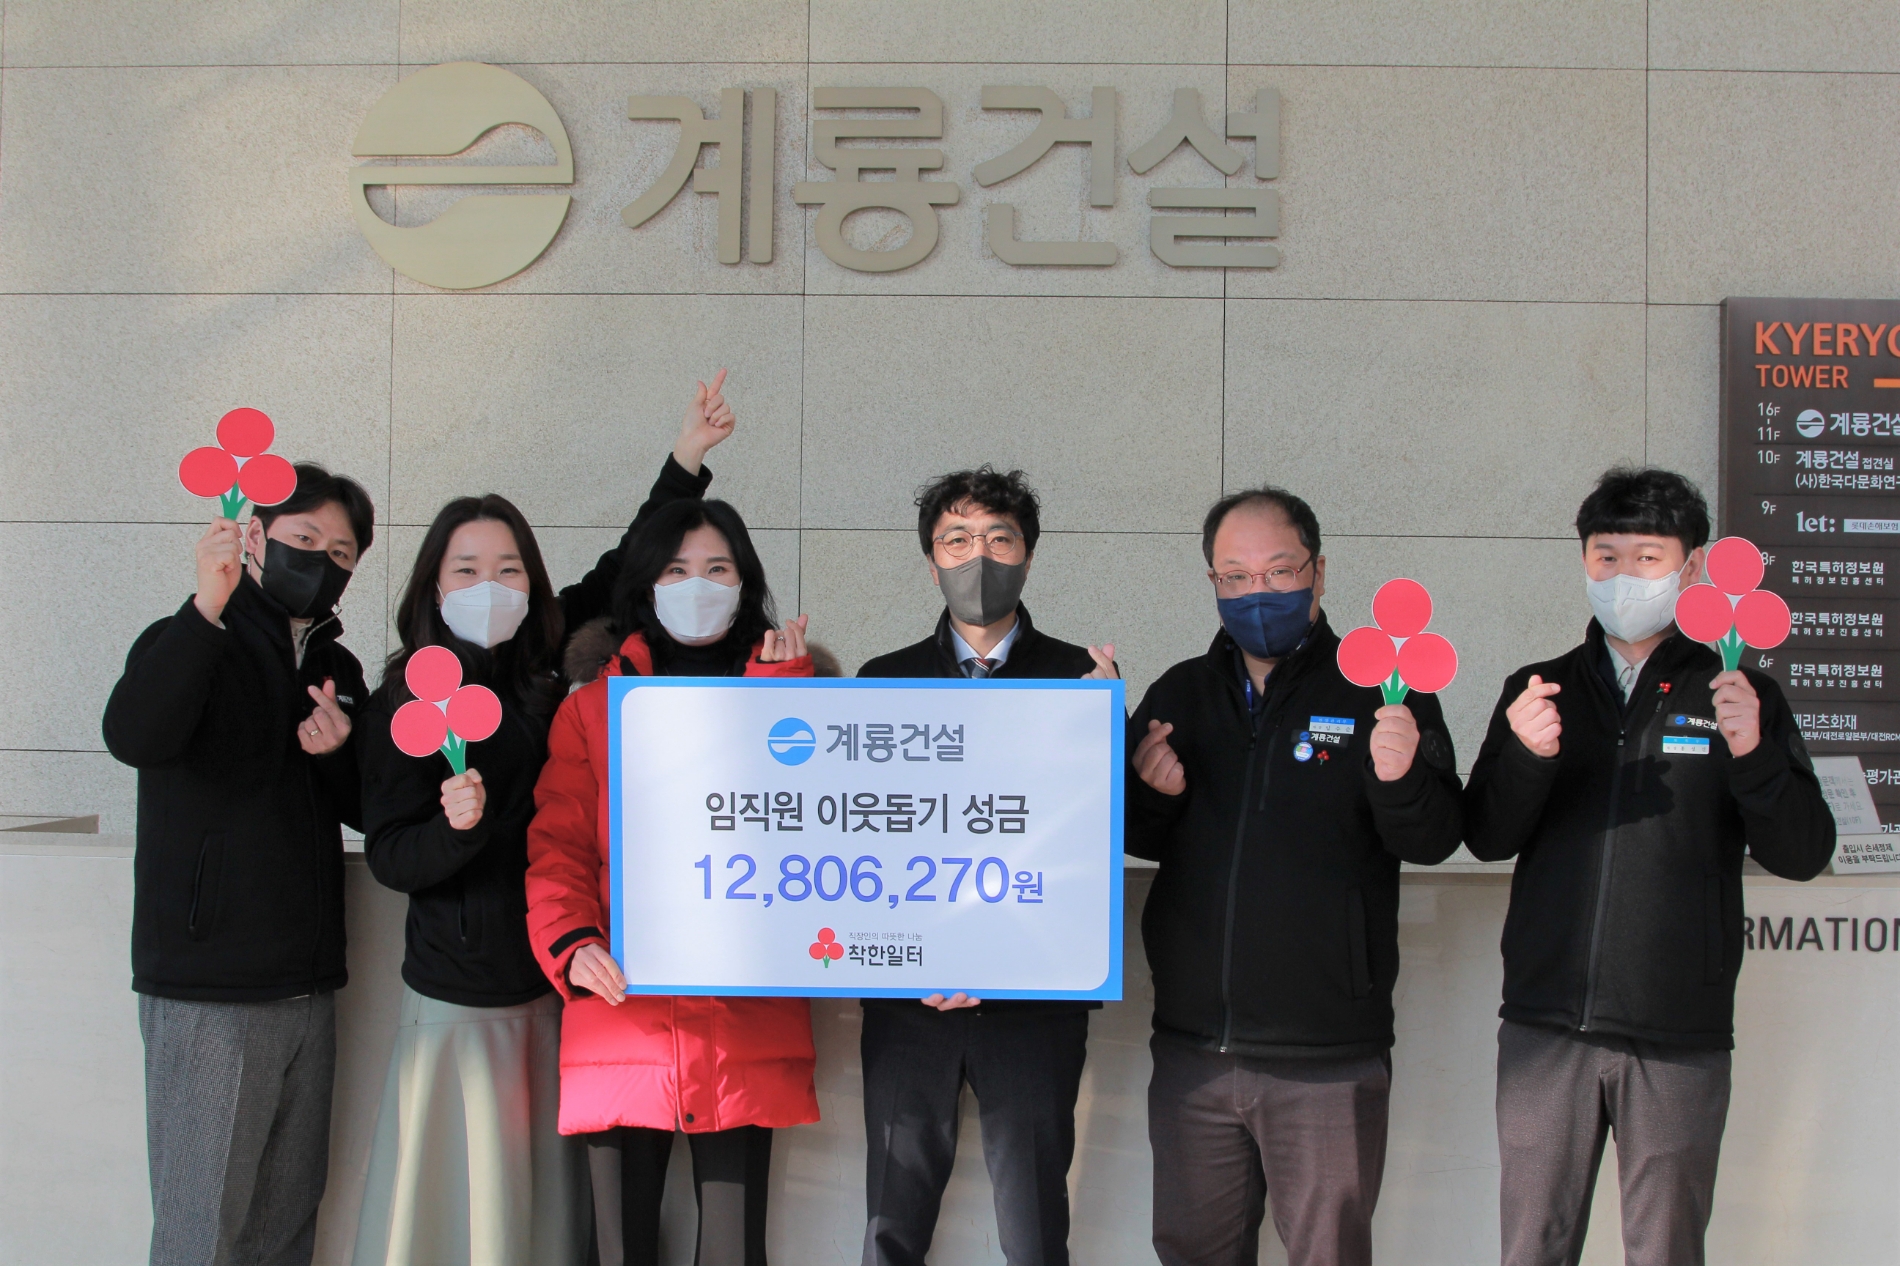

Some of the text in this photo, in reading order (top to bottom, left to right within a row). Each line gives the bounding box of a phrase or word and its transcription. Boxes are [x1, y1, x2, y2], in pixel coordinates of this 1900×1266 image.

[620, 85, 1279, 273] 계룡건설
[1755, 364, 1848, 389] TOWER
[1758, 402, 1780, 416] 16F
[1758, 427, 1780, 441] 11F
[1758, 450, 1780, 464] 10F
[1796, 451, 1894, 470] 계룡건설 접견실
[1761, 501, 1776, 515] 9F
[1761, 552, 1776, 566] 8F
[1792, 561, 1884, 575] 한국특허정보원
[1791, 612, 1883, 626] 한국특허정보원
[1759, 654, 1774, 668] 6F
[1790, 663, 1882, 677] 한국특허정보원
[825, 723, 966, 764] 계룡건설
[705, 790, 1030, 834] 임직원 이웃돕기 성금
[694, 853, 1044, 909] 12,806,270원
[848, 932, 923, 941] 직장인의 따뜻한 나눔
[1743, 916, 1900, 952] RMATIO
[848, 944, 923, 967] 착한일터
